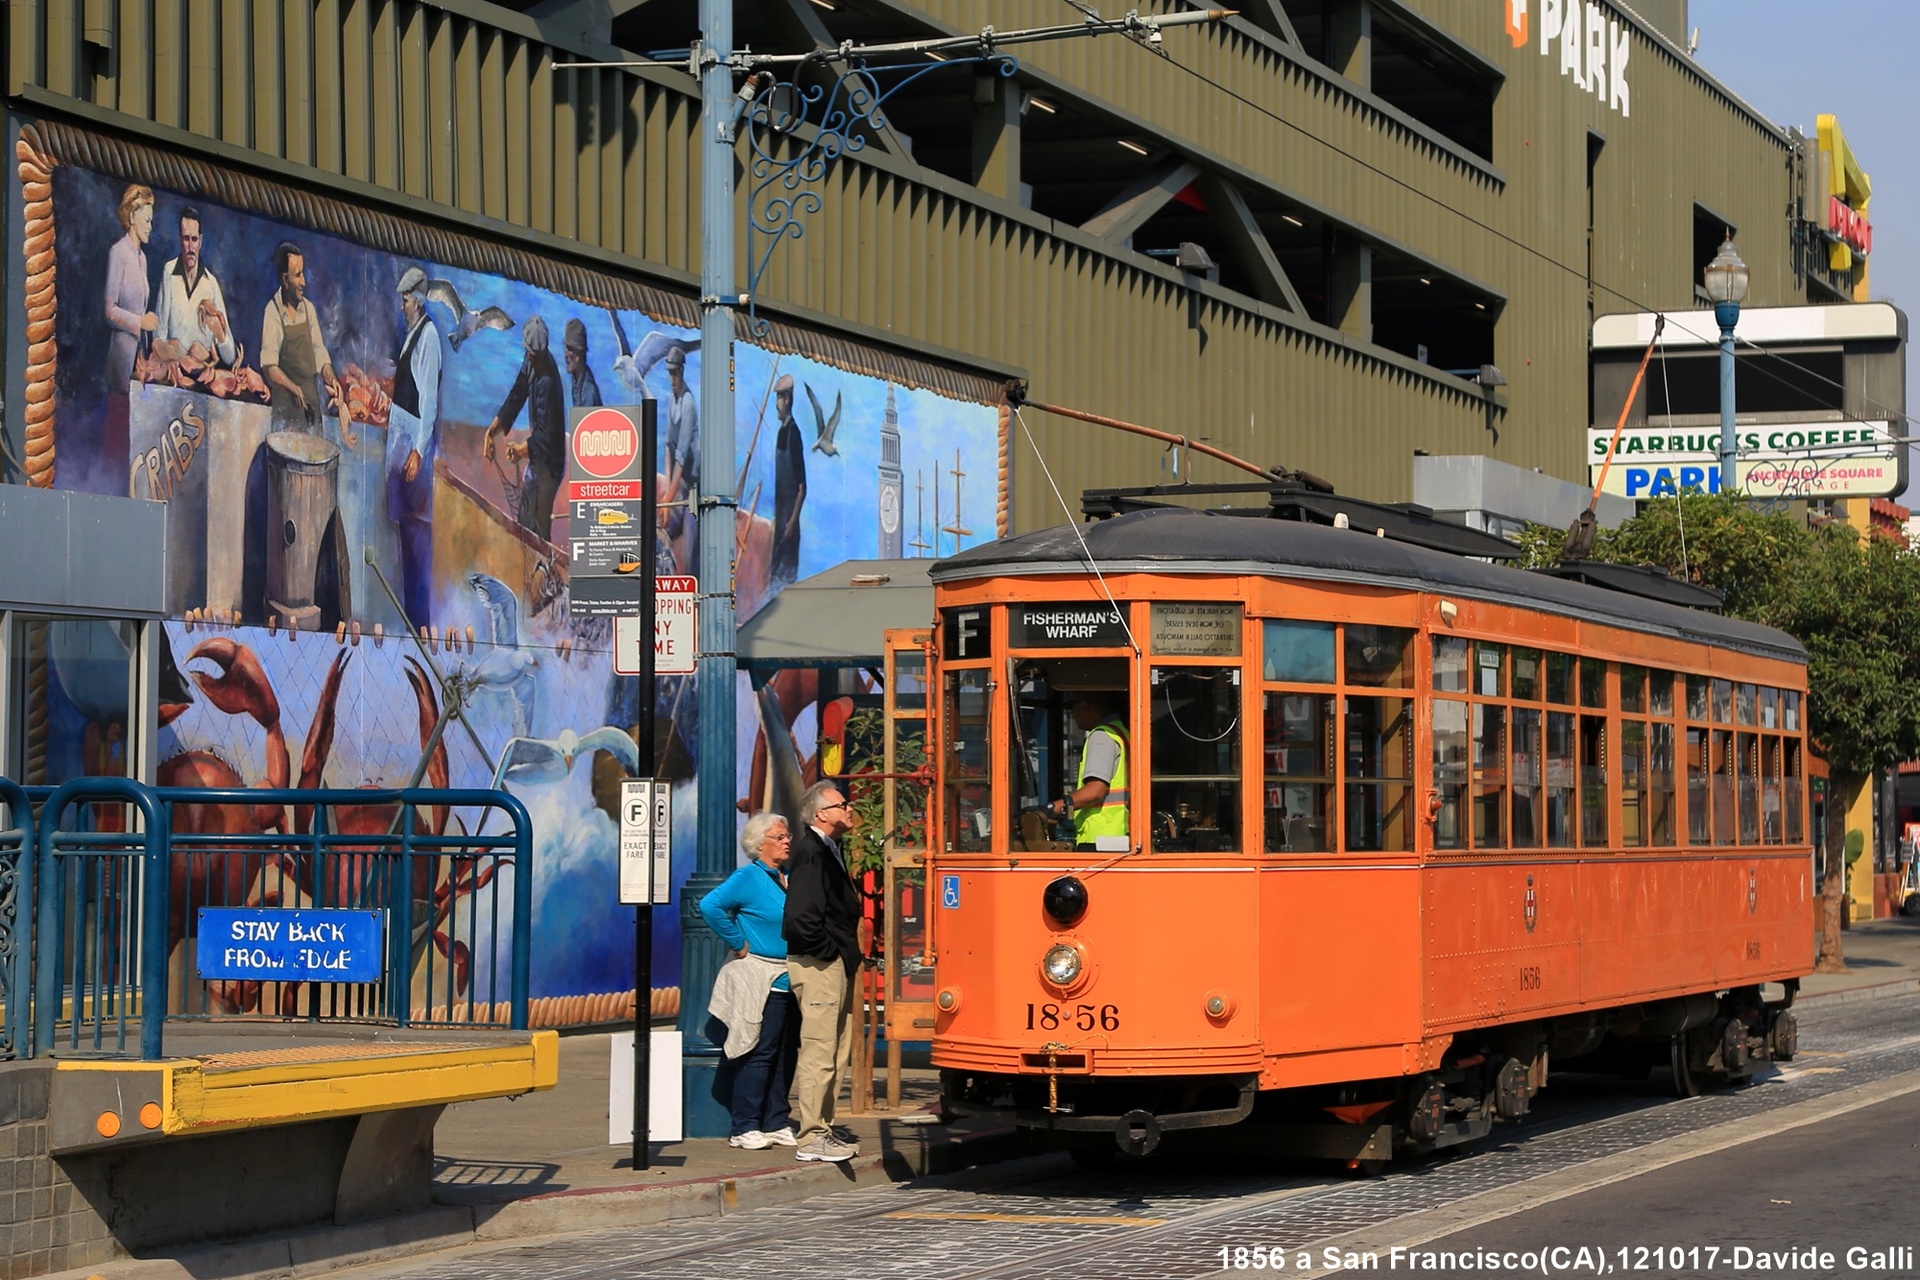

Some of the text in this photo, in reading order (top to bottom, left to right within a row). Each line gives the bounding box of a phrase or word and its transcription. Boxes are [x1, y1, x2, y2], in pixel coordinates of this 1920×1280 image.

[1540, 0, 1630, 118] PARK
[579, 429, 631, 457] MUNI
[1767, 429, 1875, 450] COFFEE
[1830, 468, 1883, 479] SQUARE
[579, 483, 631, 498] streetcar
[577, 502, 586, 519] E
[573, 542, 585, 561] F
[1022, 610, 1120, 626] FISHERMAN'S
[957, 611, 980, 656] F
[1045, 625, 1099, 639] WHARF
[630, 804, 642, 821] F
[657, 805, 664, 822] F
[623, 841, 648, 850] EXACT
[626, 850, 645, 859] FARE
[231, 920, 347, 942] STAY BACK
[1519, 966, 1541, 991] 1856
[1025, 1003, 1120, 1031] 1856
